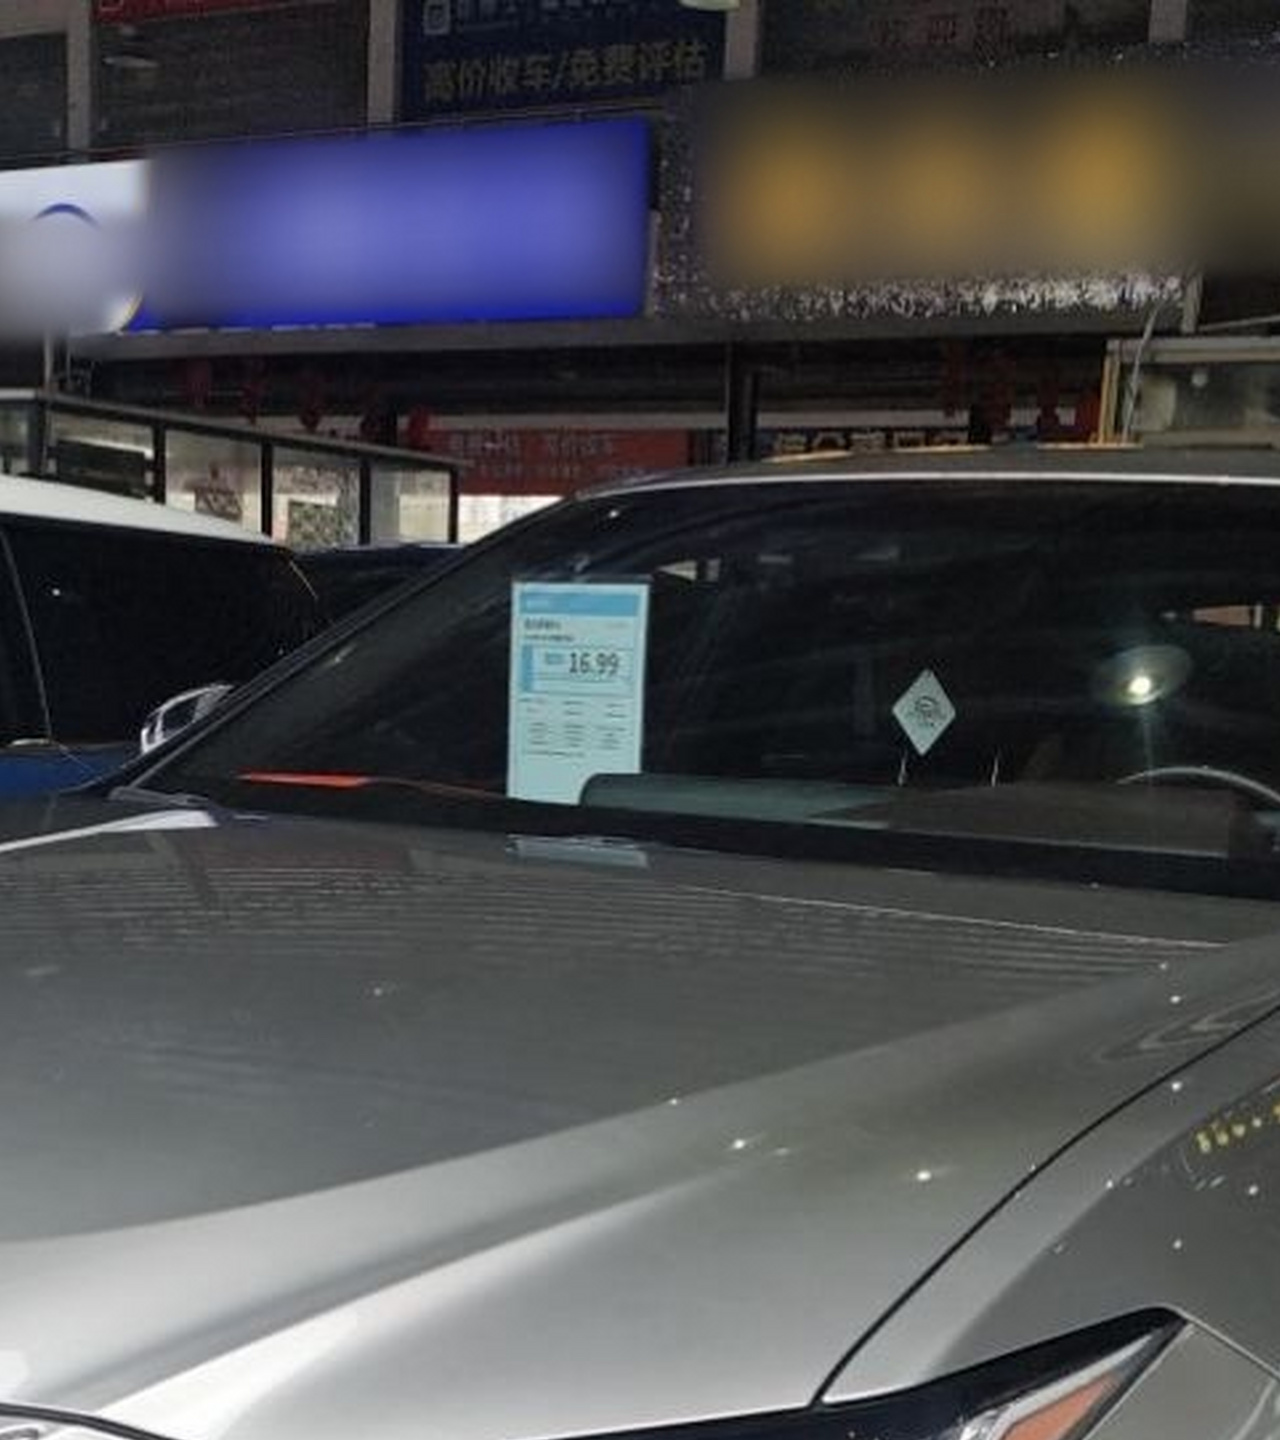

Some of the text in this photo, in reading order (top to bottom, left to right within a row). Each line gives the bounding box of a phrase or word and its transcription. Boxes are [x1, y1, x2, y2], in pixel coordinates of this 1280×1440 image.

[423, 38, 708, 102] 高价收车/免费评估
[569, 651, 619, 676] 16.99
